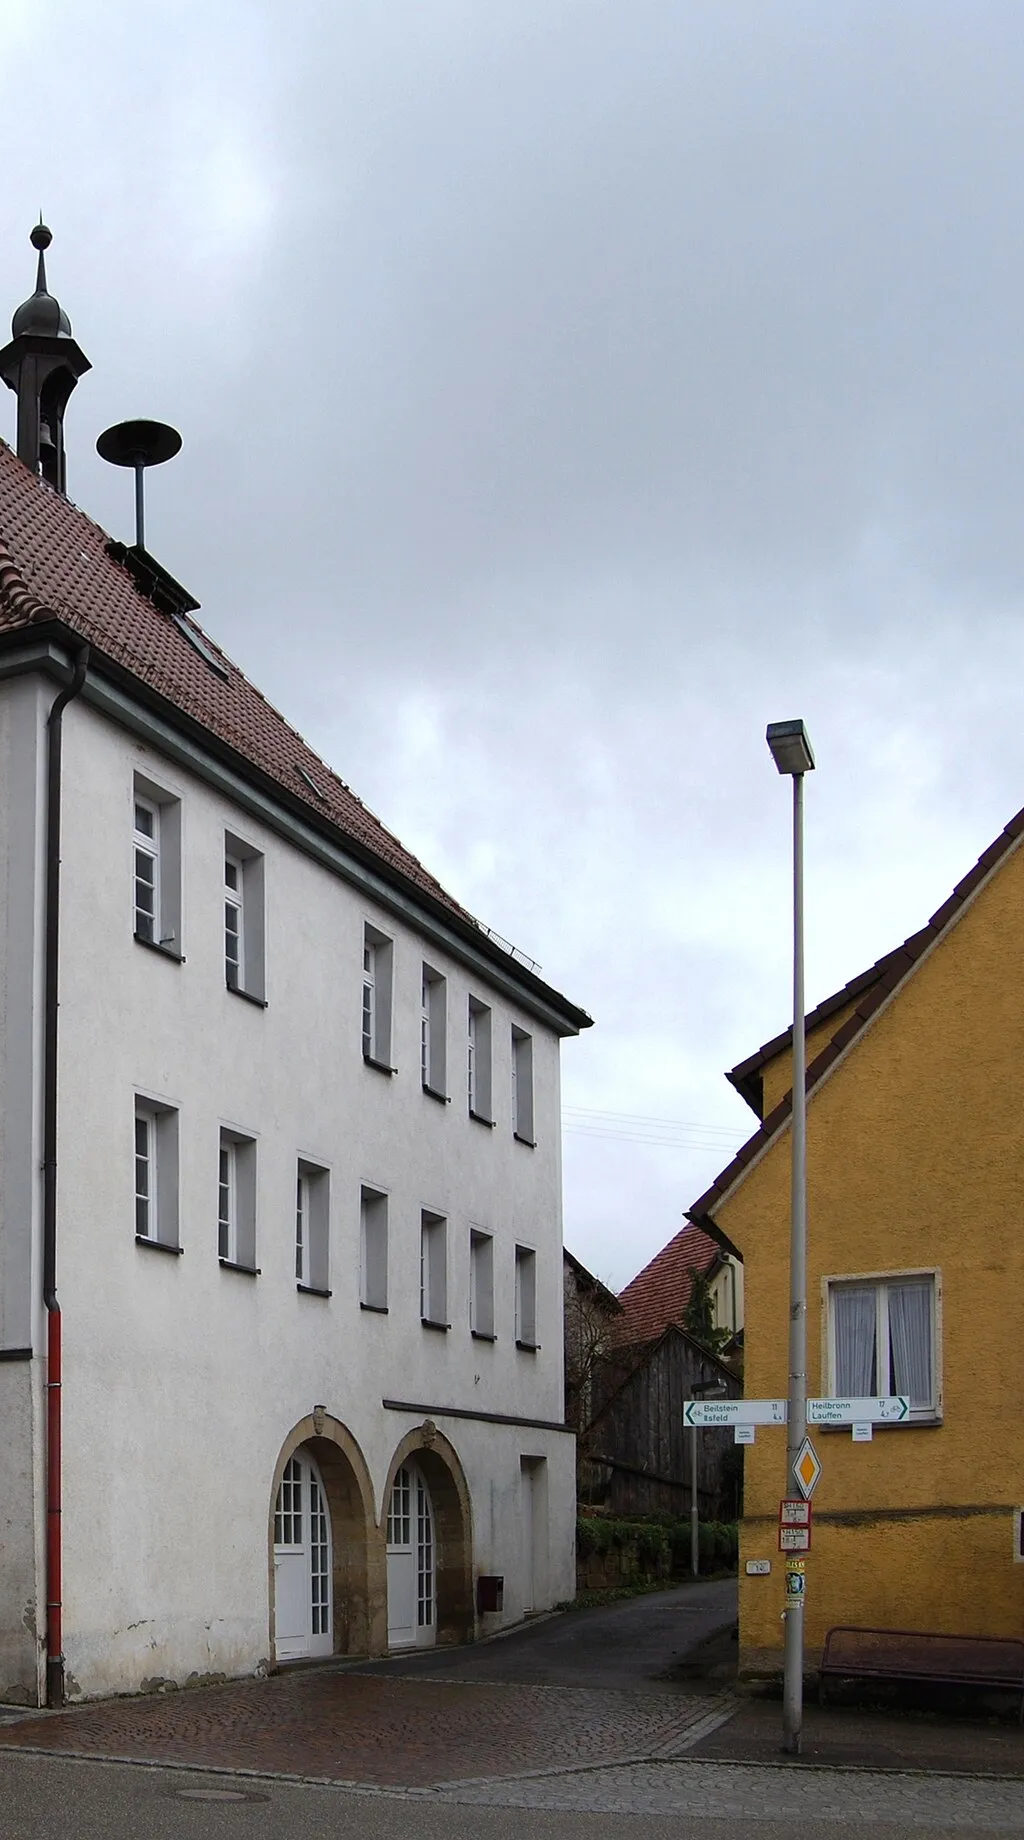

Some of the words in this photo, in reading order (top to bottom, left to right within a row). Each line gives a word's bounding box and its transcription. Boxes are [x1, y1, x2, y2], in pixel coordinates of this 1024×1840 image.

[703, 1404, 739, 1412] Beilstein
[812, 1402, 851, 1410] Heilbronn
[703, 1414, 729, 1422] Ilsfeld
[812, 1412, 842, 1420] Lauffen
